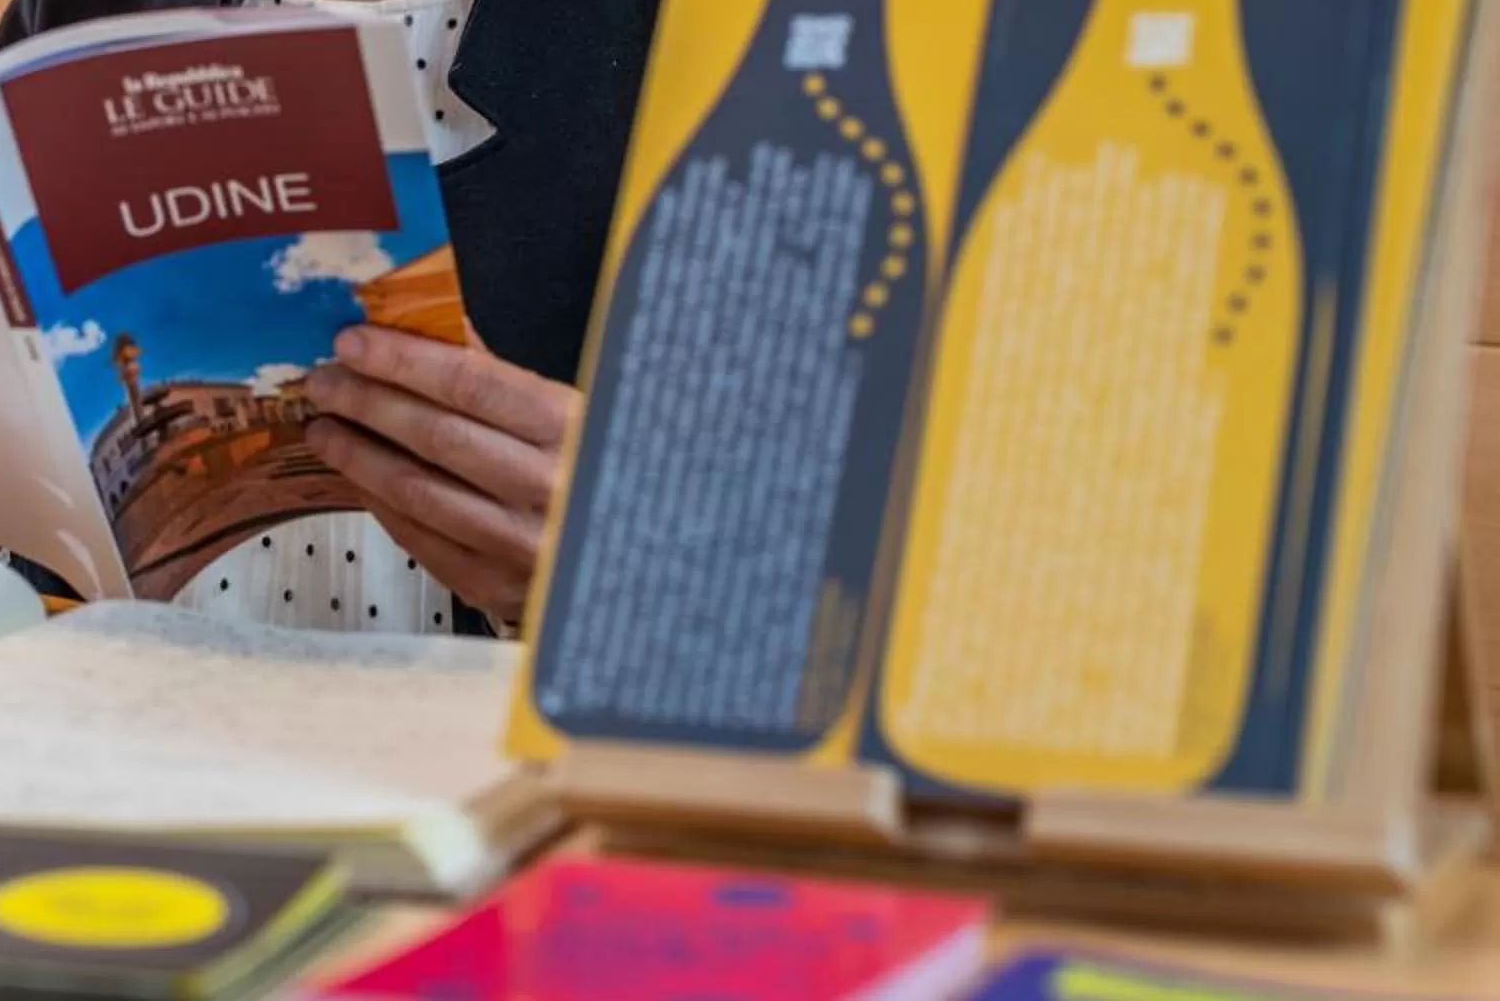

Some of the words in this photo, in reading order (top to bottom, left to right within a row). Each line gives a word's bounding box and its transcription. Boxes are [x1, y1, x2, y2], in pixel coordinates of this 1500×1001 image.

[103, 95, 146, 127] LE
[152, 75, 280, 115] GUIDE
[119, 172, 318, 238] UDINE
